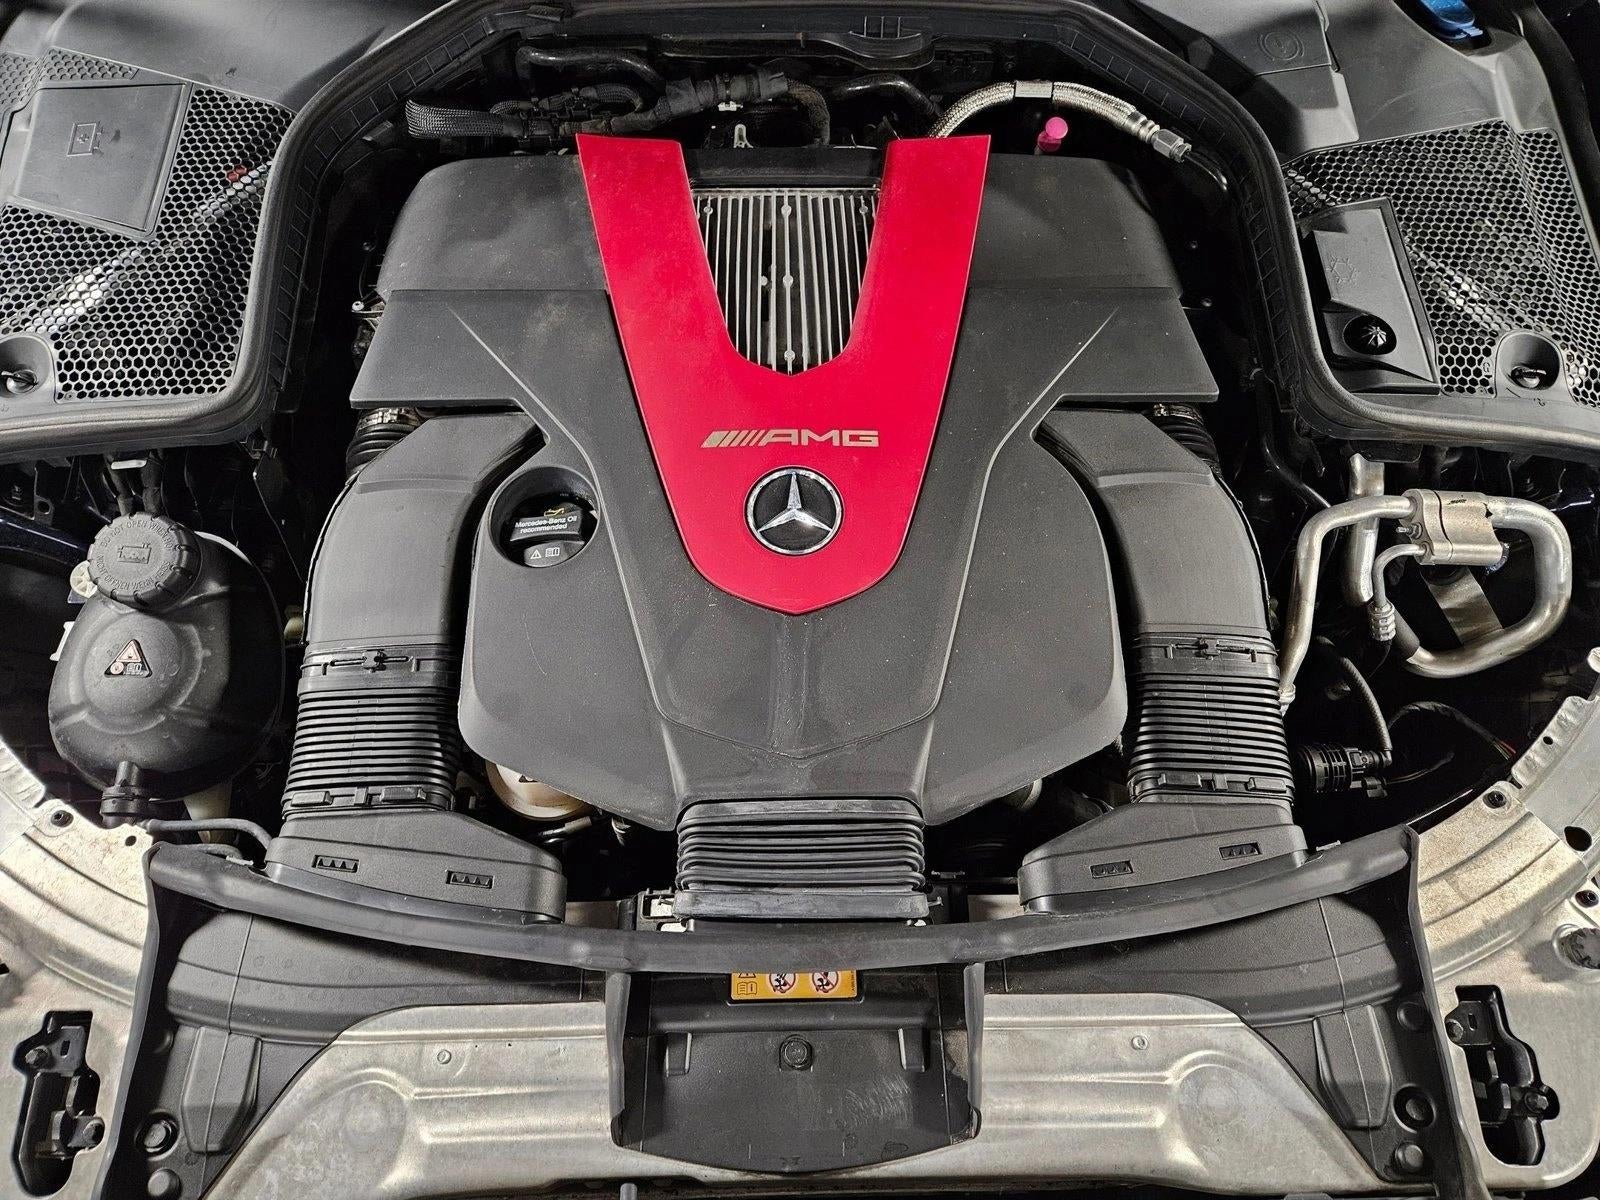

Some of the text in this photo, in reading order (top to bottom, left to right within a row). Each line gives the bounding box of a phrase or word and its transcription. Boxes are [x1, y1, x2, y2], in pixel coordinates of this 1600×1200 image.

[757, 428, 880, 448] AMG
[126, 519, 148, 529] OPEN
[514, 515, 578, 528] Mercedes-Benz Oil
[520, 523, 568, 533] recommended
